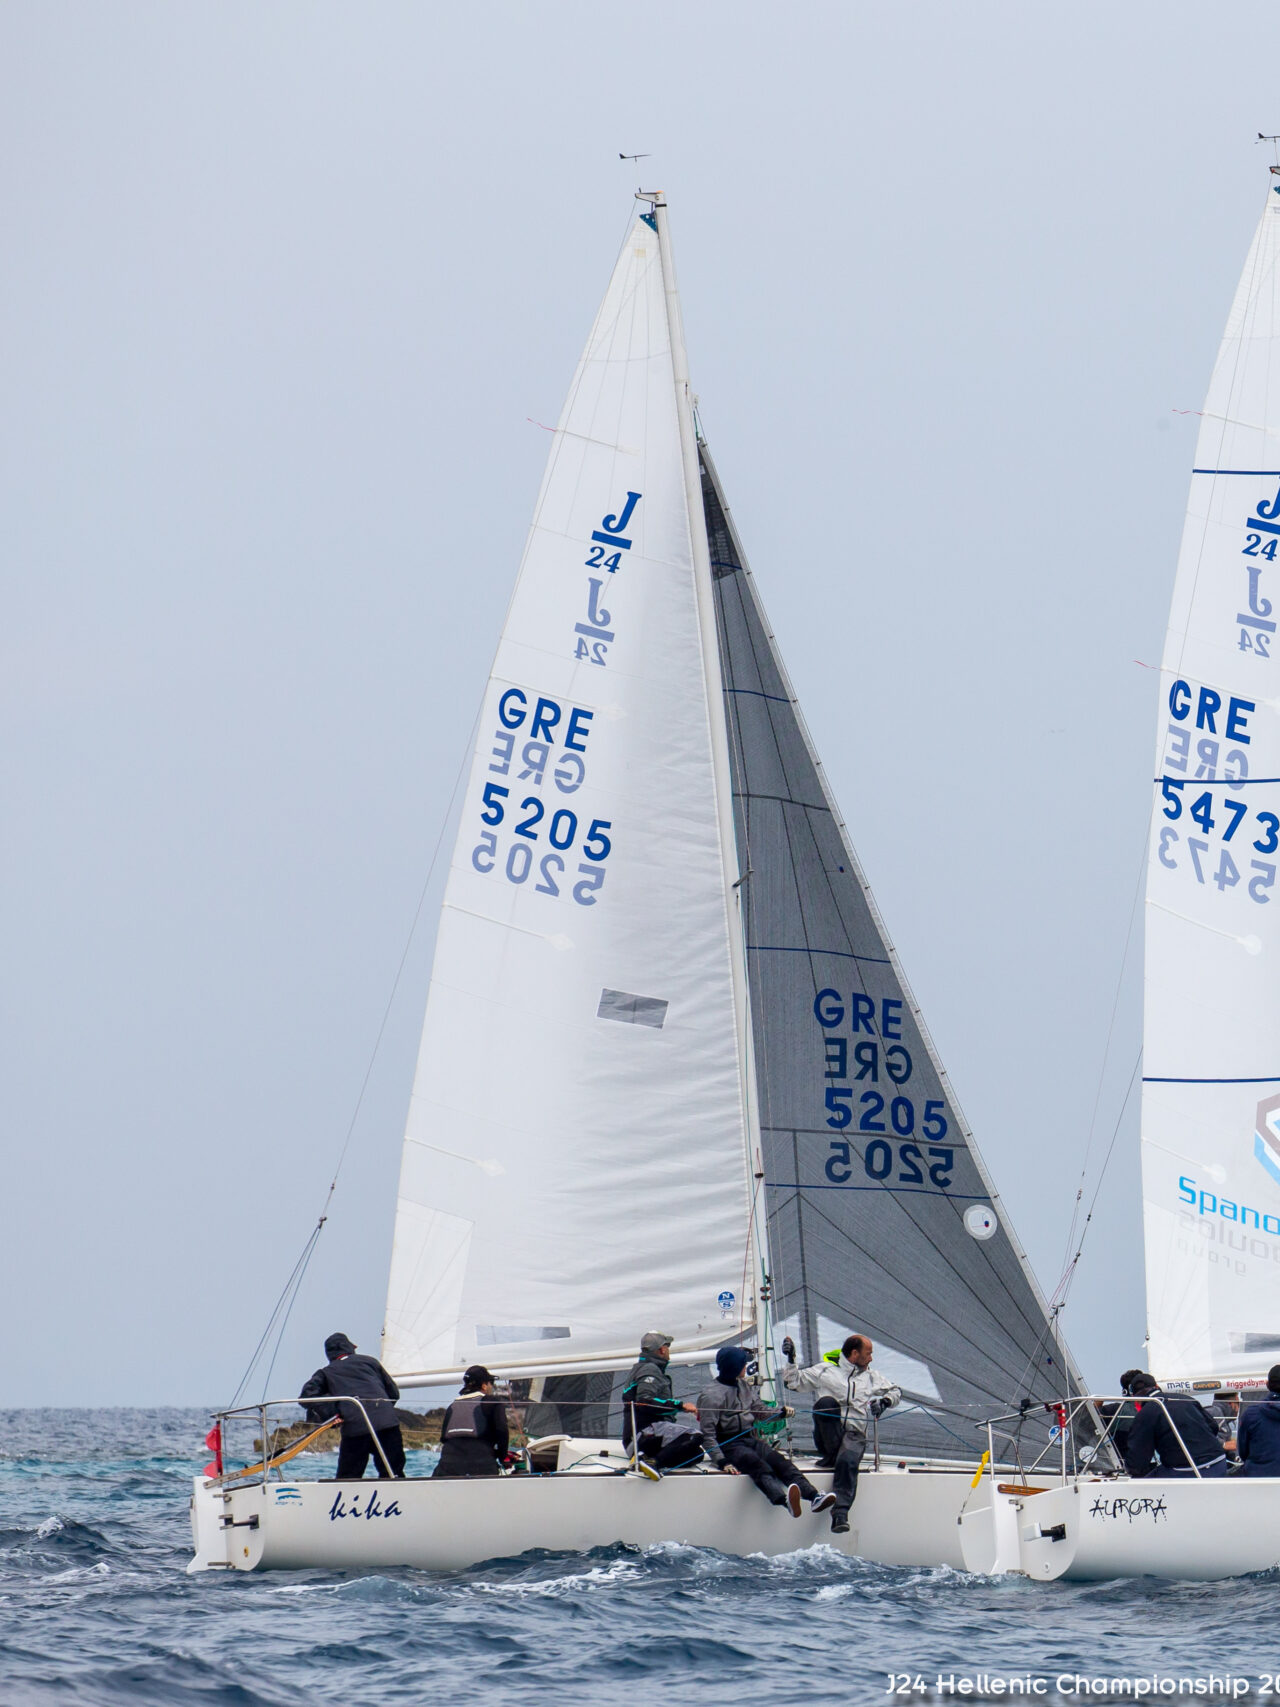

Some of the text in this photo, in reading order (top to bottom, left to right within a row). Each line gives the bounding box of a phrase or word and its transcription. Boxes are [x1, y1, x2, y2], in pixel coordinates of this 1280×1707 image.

[602, 491, 642, 533] J
[584, 546, 623, 574] 24
[1242, 534, 1278, 561] 24
[499, 688, 594, 752] GRE
[1168, 679, 1255, 745] GRE
[480, 782, 612, 861] 5205
[1161, 775, 1280, 854] 5473
[813, 988, 902, 1040] GRE
[824, 1087, 947, 1141] 5205
[329, 1490, 402, 1520] kika
[1089, 1495, 1167, 1523] AURORA
